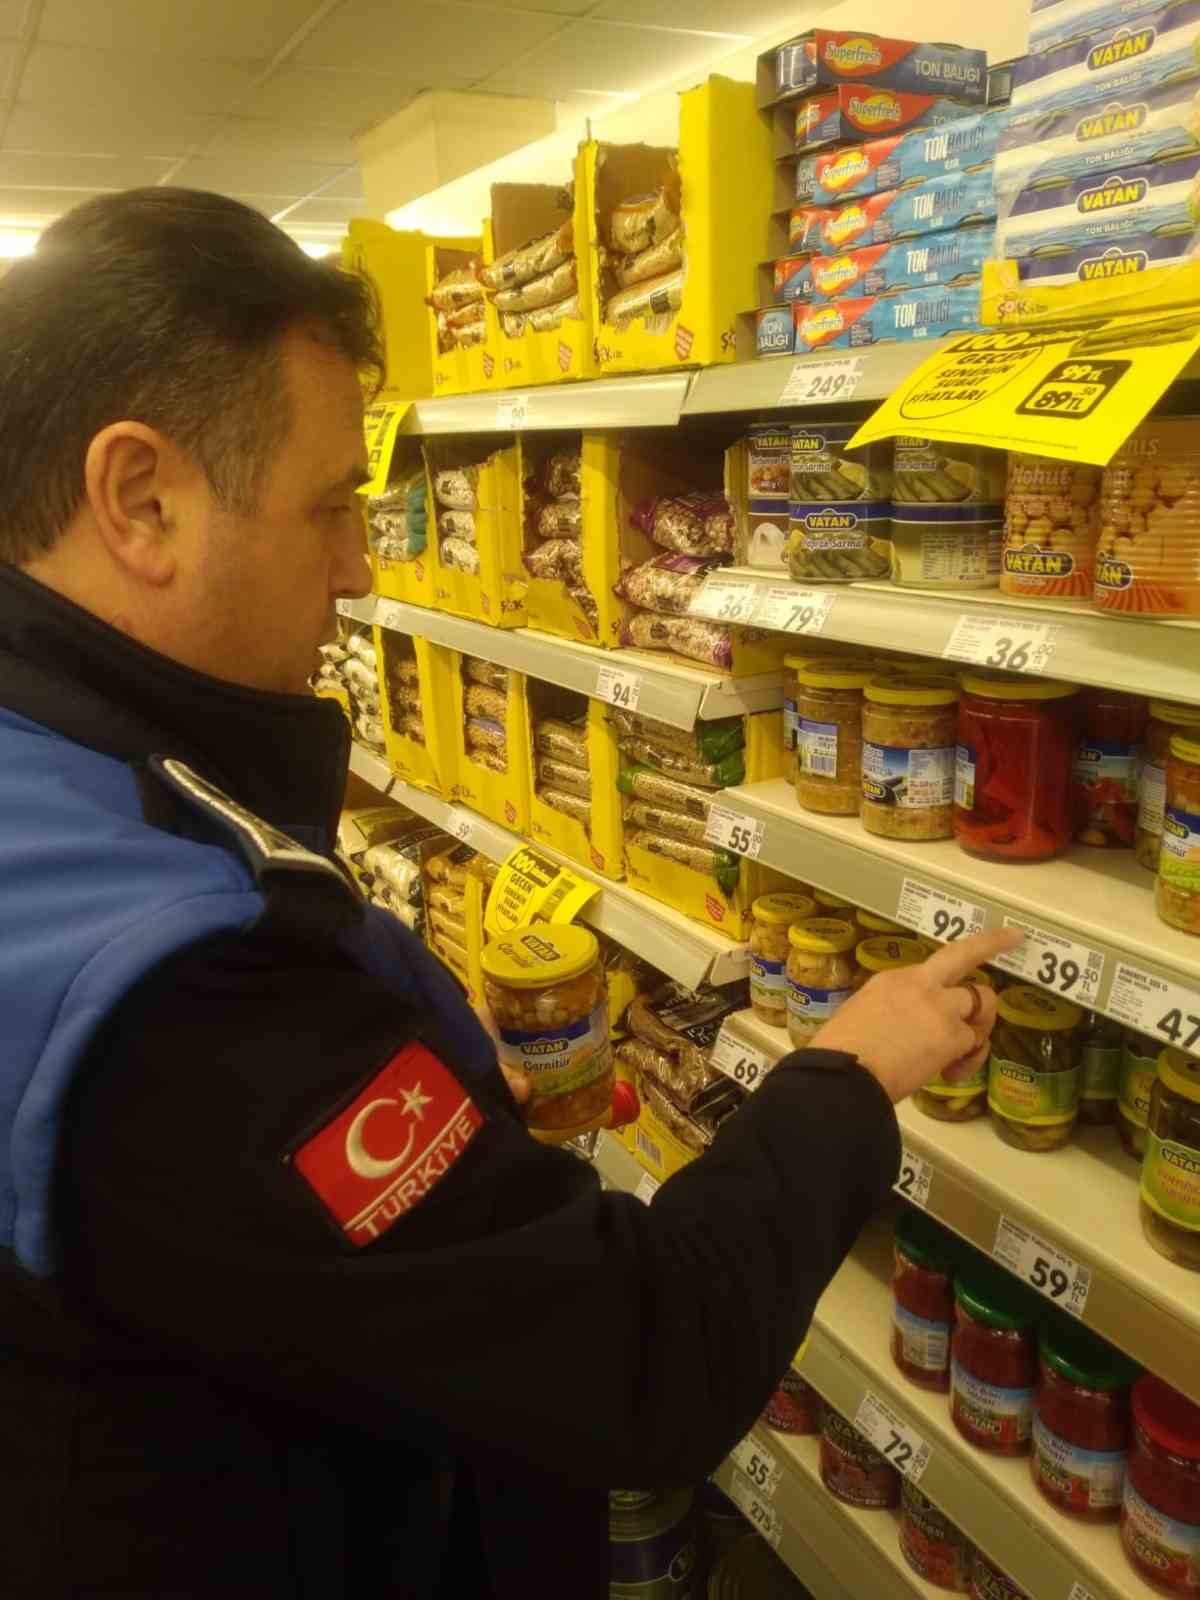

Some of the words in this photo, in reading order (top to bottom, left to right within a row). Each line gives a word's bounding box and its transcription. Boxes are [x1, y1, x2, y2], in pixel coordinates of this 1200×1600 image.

[827, 41, 880, 65] Superfresh
[1091, 33, 1147, 66] VATAN
[913, 58, 940, 77] TON
[1082, 110, 1139, 139] VATAN
[924, 134, 947, 162] TON
[913, 192, 936, 220] TON
[1083, 185, 1139, 210] VATAN
[907, 248, 929, 273] TON
[1083, 257, 1139, 280] VATAN
[894, 303, 917, 328] TON
[806, 374, 847, 398] 249
[808, 516, 850, 528] VATAN
[1006, 553, 1063, 574] VATAN
[782, 605, 814, 631] 79
[986, 637, 1032, 670] 36
[612, 682, 632, 706] 94
[728, 826, 752, 853] 55
[934, 910, 966, 941] 92
[1037, 951, 1080, 991] 39
[1156, 1008, 1200, 1048] 47
[523, 1040, 567, 1055] VATAN
[734, 1058, 758, 1085] 69
[899, 1166, 915, 1195] 2
[1030, 1257, 1068, 1297] 59
[884, 1430, 912, 1470] 72
[747, 1455, 769, 1486] 55
